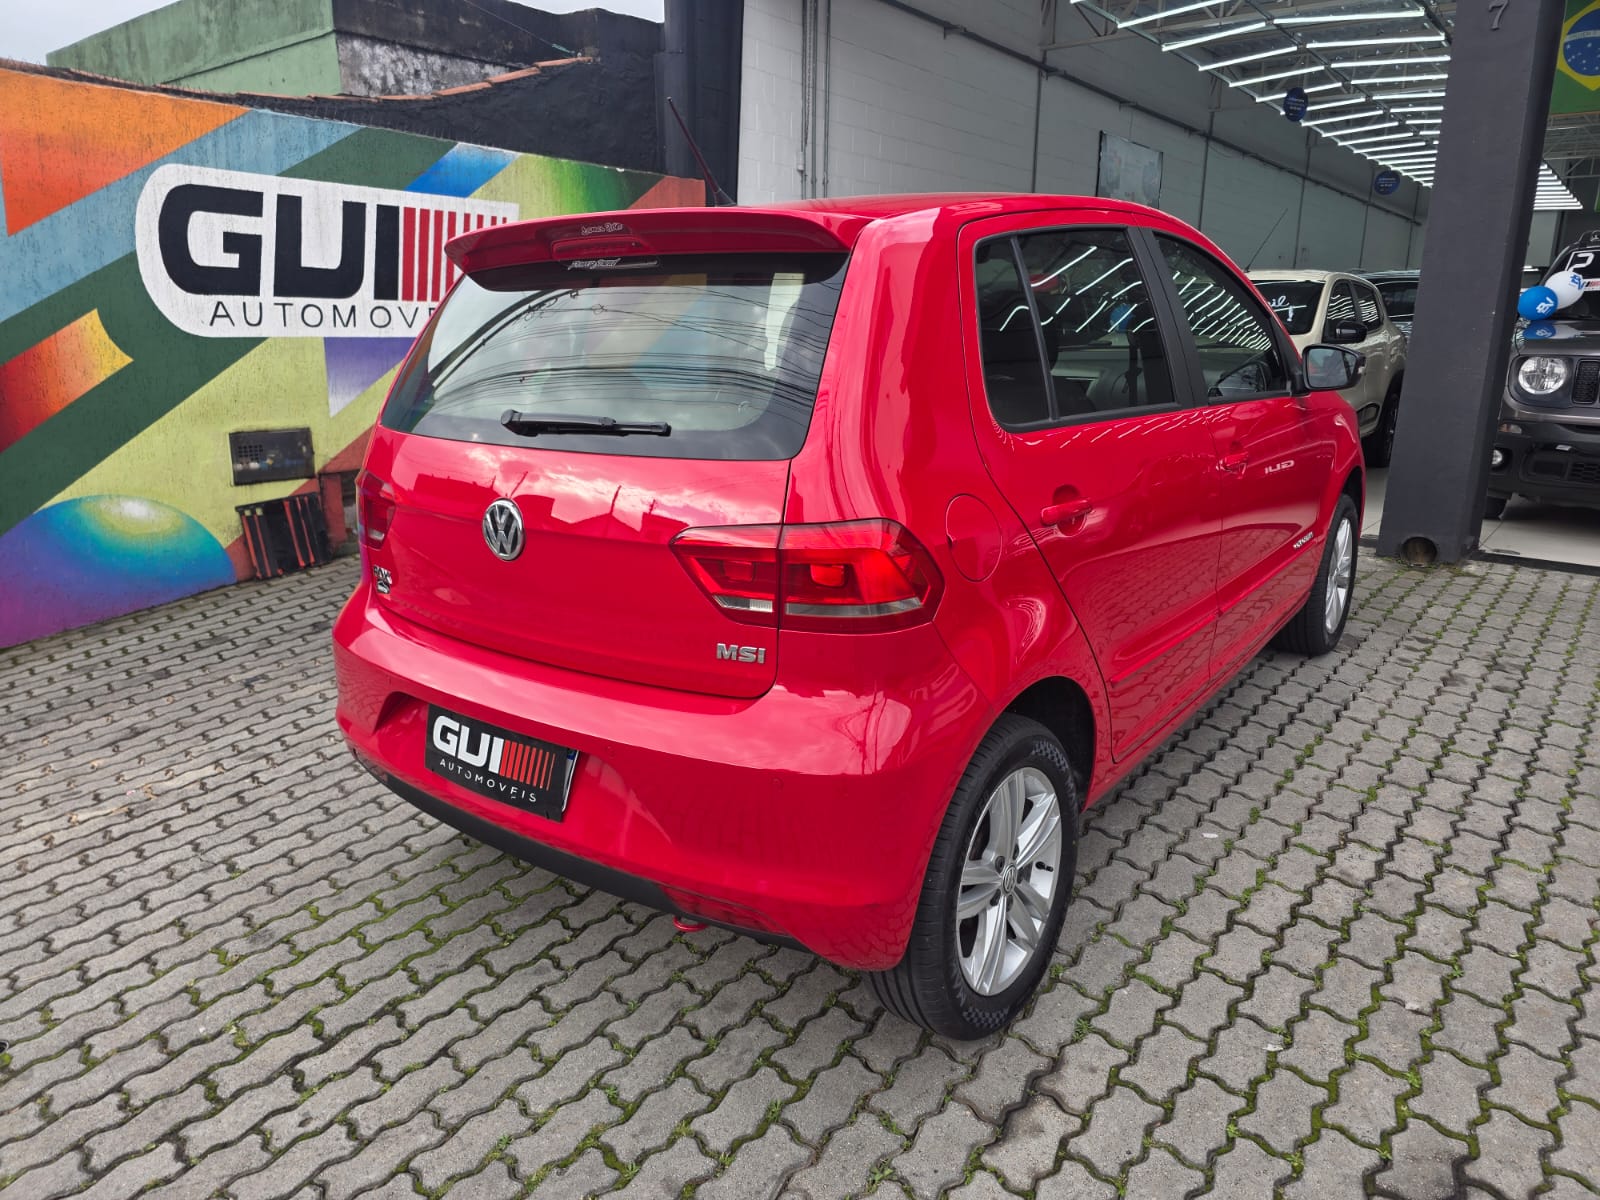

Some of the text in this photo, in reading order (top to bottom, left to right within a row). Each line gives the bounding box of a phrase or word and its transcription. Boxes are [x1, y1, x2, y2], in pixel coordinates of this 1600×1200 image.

[158, 184, 400, 300] GUI
[716, 643, 766, 664] MSI
[432, 715, 505, 775] GUI
[439, 758, 537, 803] AUTOMOVEIS
